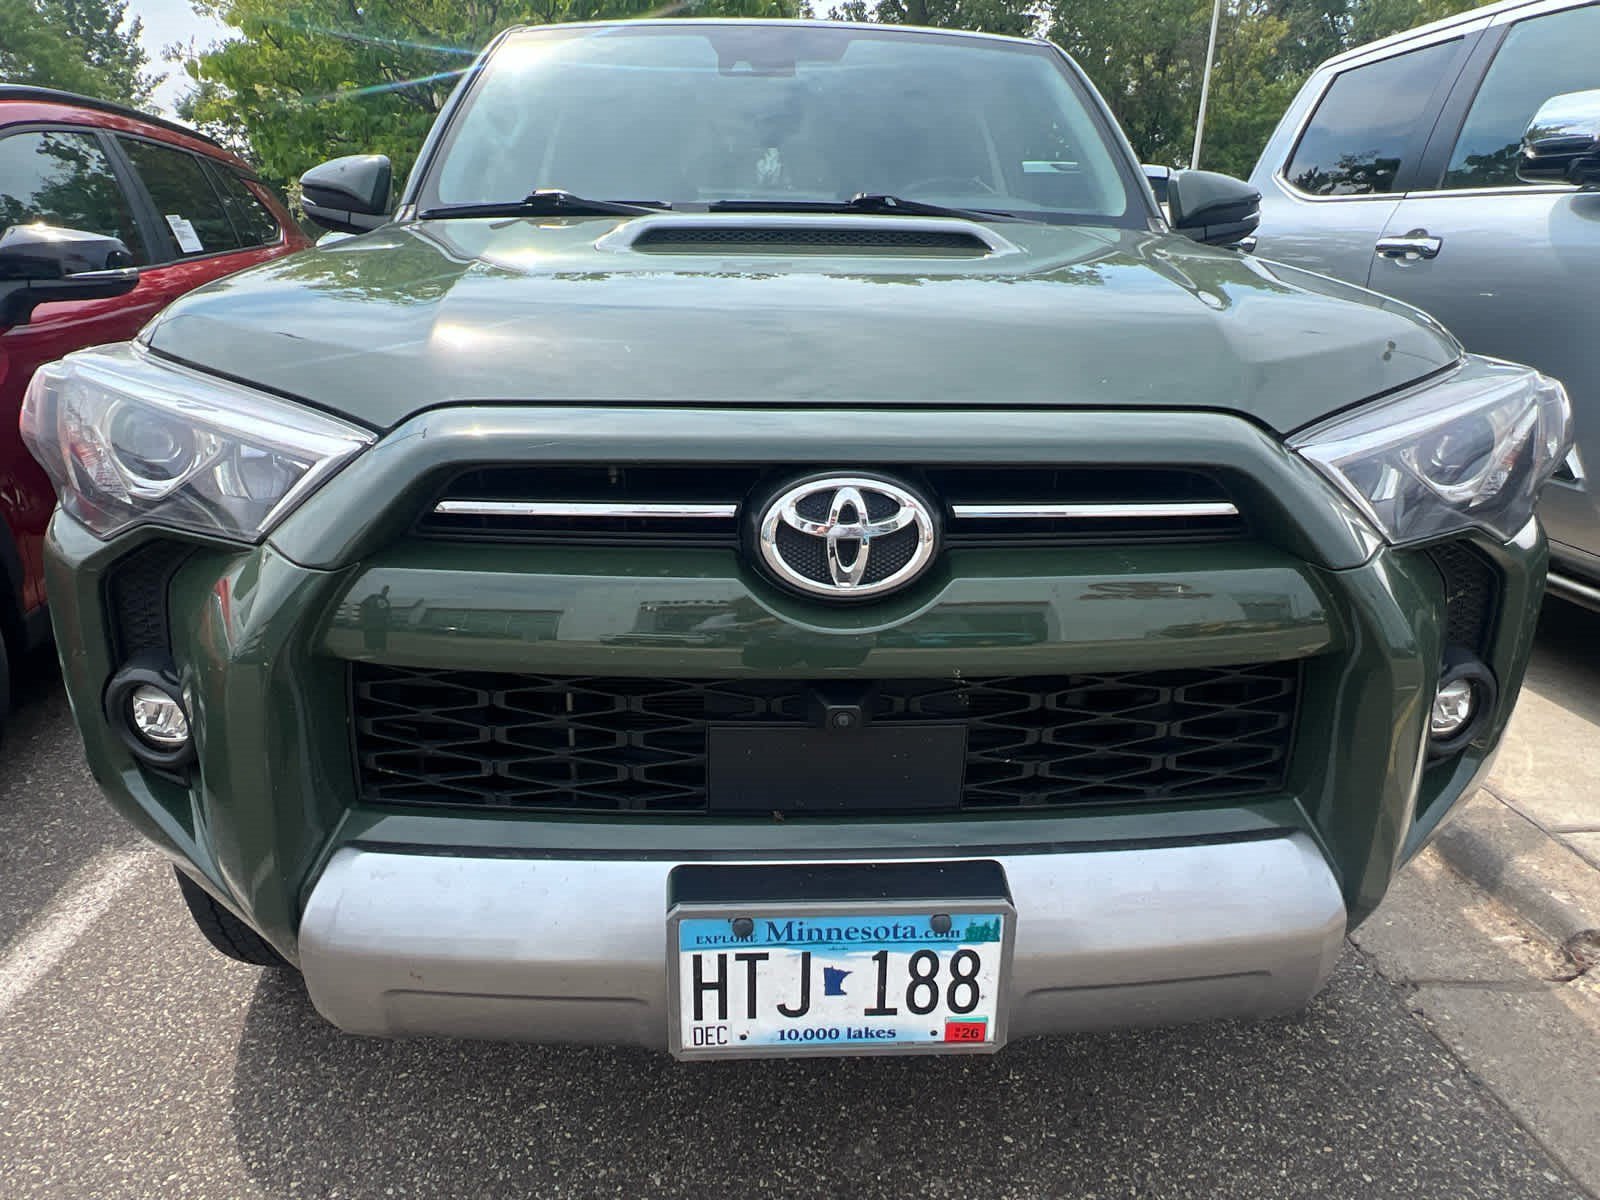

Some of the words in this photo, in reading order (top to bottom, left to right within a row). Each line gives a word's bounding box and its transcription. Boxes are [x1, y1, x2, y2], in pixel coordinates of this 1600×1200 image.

[692, 951, 811, 1020] HTJ
[864, 949, 981, 1016] 188
[693, 1026, 728, 1046] DEC
[778, 1028, 840, 1042] 10,000
[847, 1026, 897, 1040] lakes
